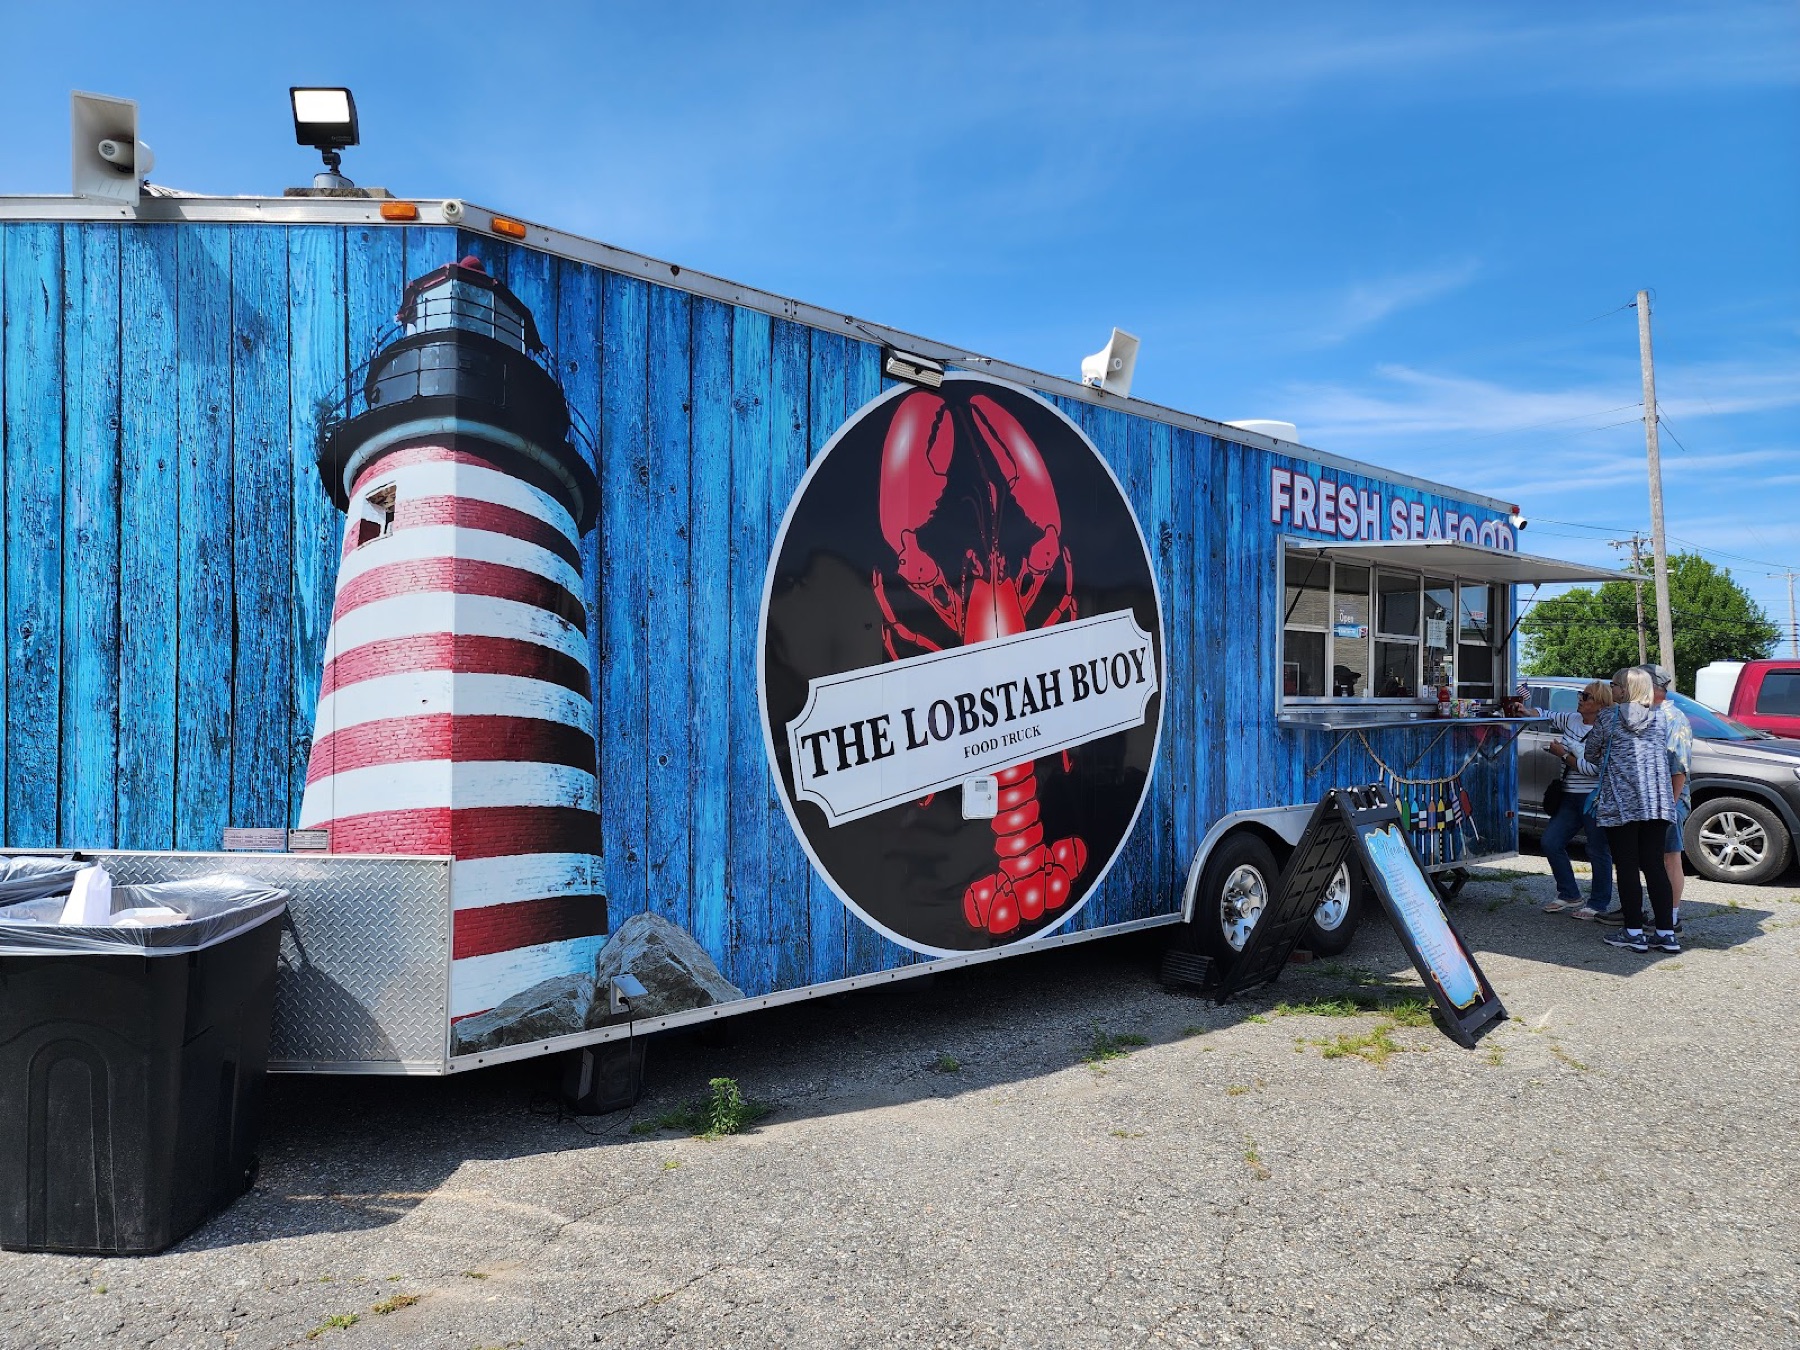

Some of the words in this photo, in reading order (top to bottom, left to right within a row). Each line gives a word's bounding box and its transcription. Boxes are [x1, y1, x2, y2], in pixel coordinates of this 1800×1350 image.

[1271, 467, 1381, 541] FRESH
[1391, 498, 1514, 551] SEAFOOD
[801, 714, 895, 778] THE
[901, 669, 1064, 750] LOBSTAH
[1069, 647, 1146, 702] BUOY
[964, 738, 999, 759] FOOD
[1001, 724, 1042, 747] TRUCK
